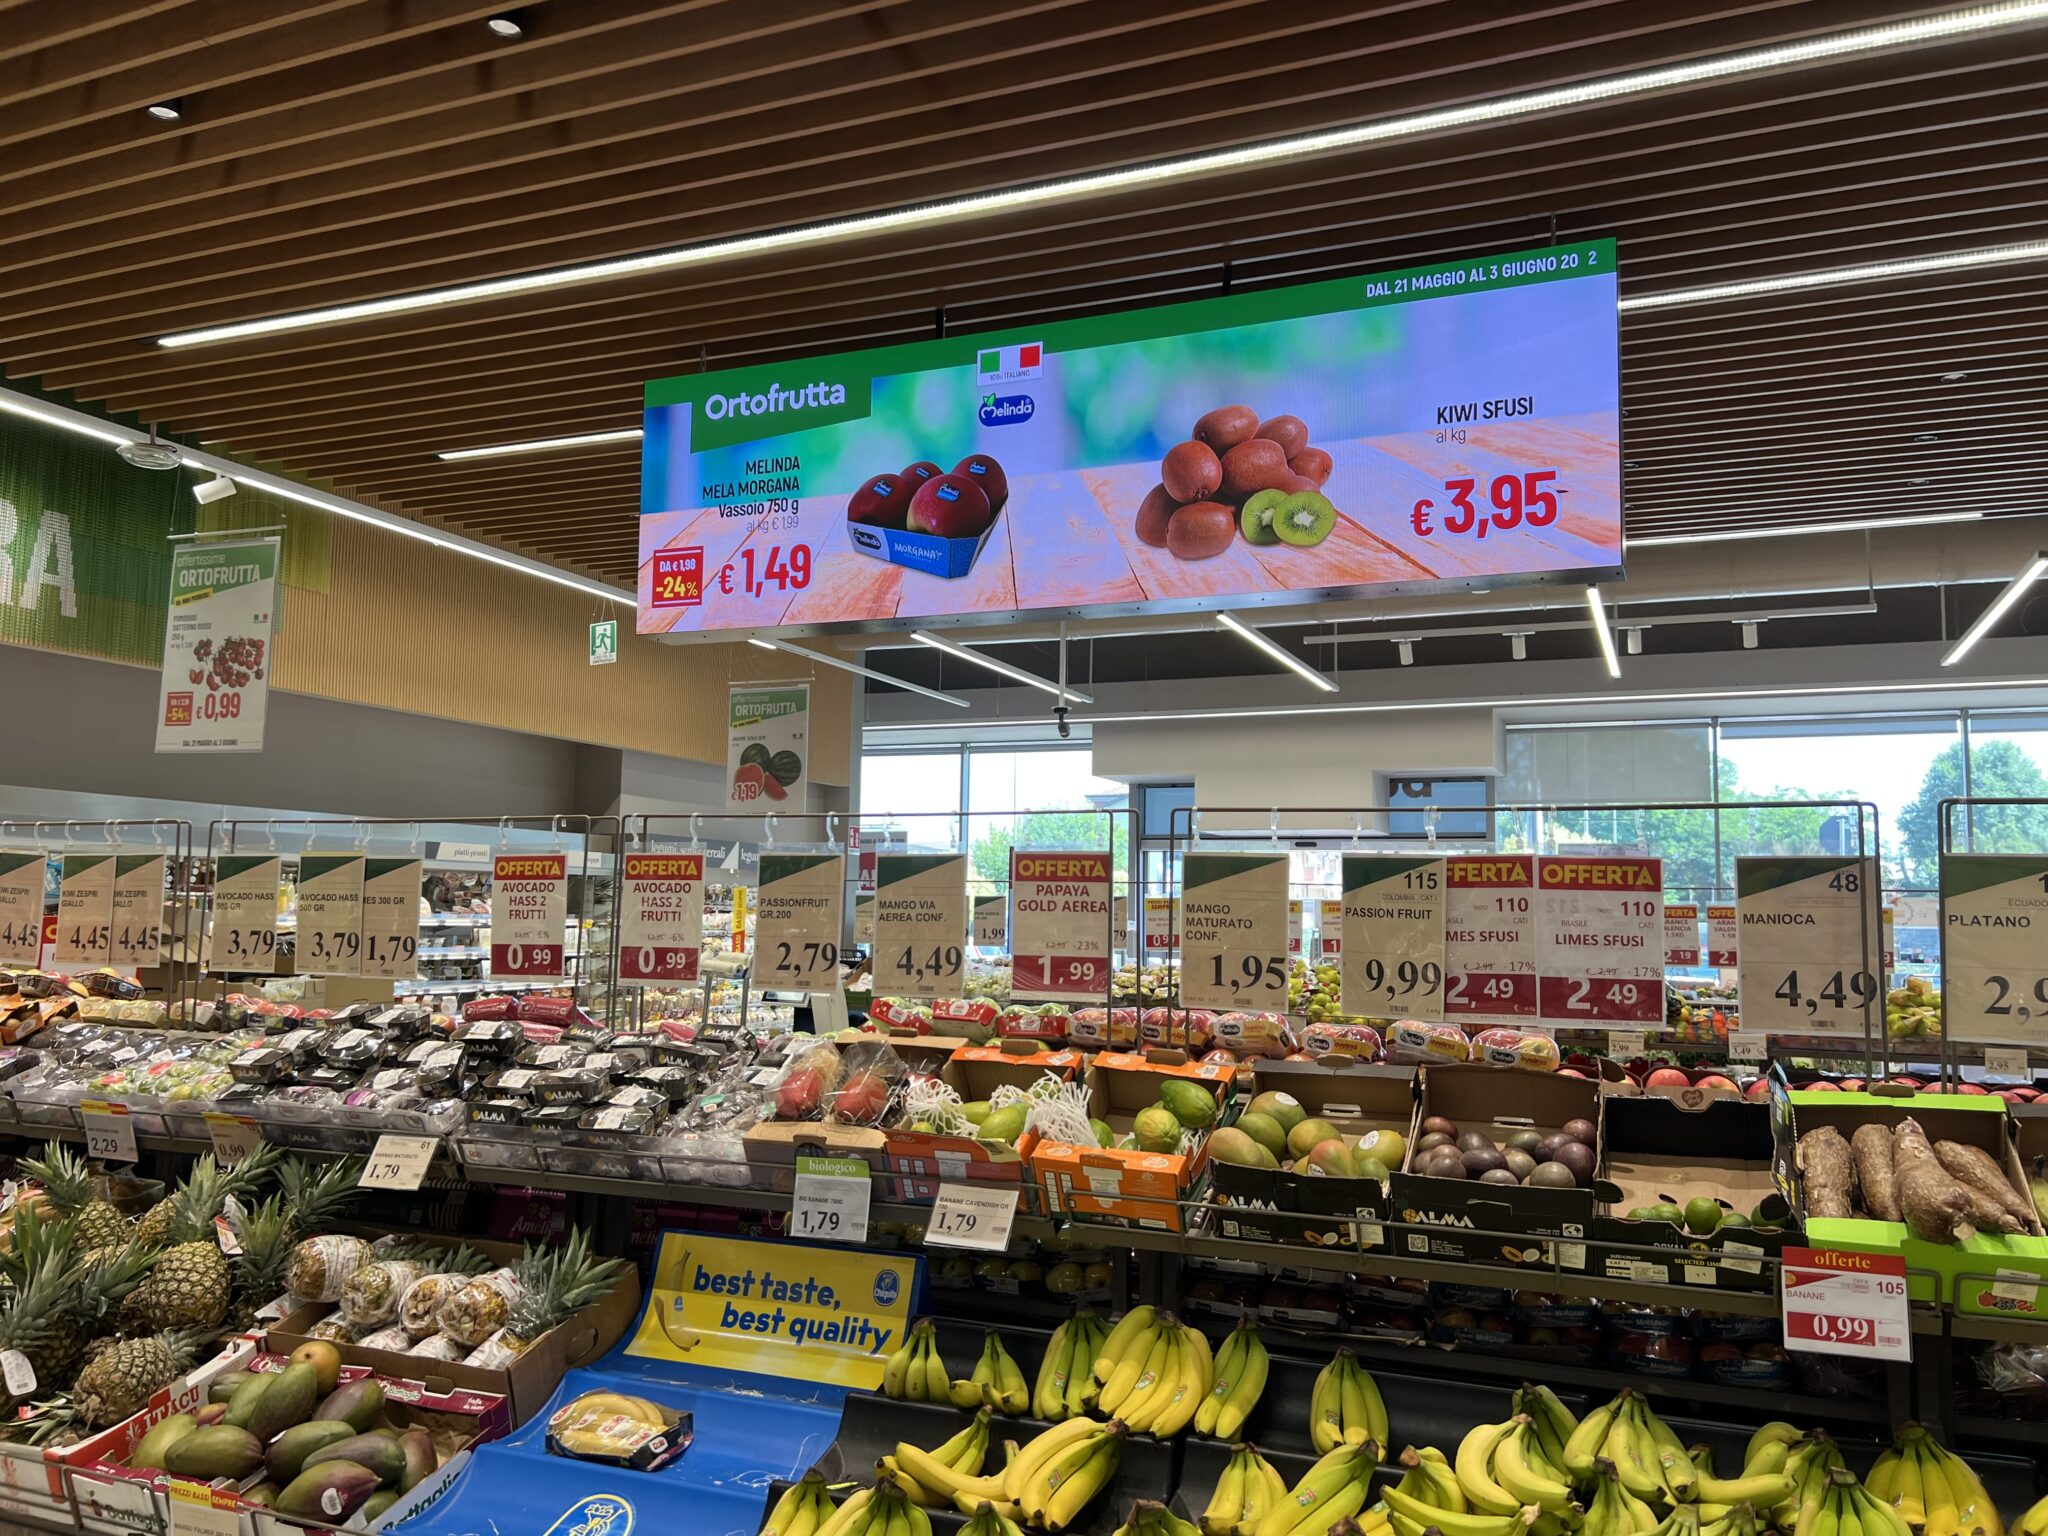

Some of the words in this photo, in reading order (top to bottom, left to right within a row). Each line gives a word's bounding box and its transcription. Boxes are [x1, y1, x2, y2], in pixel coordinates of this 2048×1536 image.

[1366, 283, 1391, 297] DAL
[1394, 278, 1408, 292] 21
[1412, 270, 1465, 290] MAGGIO
[1469, 267, 1486, 282] AL
[1490, 265, 1498, 280] 3
[1502, 256, 1556, 278] GIUGNO
[1004, 370, 1030, 378] ITALIANO
[705, 381, 846, 421] Ortofrutta
[981, 400, 1032, 419] Melinda
[1436, 404, 1478, 424] KIWI
[1482, 396, 1534, 421] SFUSI
[1436, 428, 1448, 444] al
[1450, 428, 1466, 444] kg
[746, 456, 800, 476] MELINDA
[702, 482, 734, 500] MELA
[738, 476, 800, 496] MORGANA
[719, 502, 764, 518] Vassoio
[768, 498, 788, 513] 750
[792, 499, 799, 514] g
[1410, 499, 1434, 536] €
[1444, 470, 1557, 538] 3,95
[747, 520, 755, 532] al
[772, 517, 779, 530] €
[782, 516, 799, 530] 1,99
[894, 543, 936, 558] MORGANA
[660, 561, 672, 572] DA
[672, 562, 678, 571] €
[680, 558, 696, 572] 1,98
[718, 564, 735, 594] €
[741, 544, 812, 598] 1,49
[180, 564, 260, 587] ORTOFRUTTA
[656, 576, 697, 598] -24%
[204, 692, 241, 722] 0,99
[735, 702, 797, 716] ORTOFRUTTA
[736, 782, 758, 802] 1,19
[496, 860, 561, 876] OFFERTA
[627, 860, 698, 876] OFFERTA
[1018, 860, 1106, 878] OFFERTA
[1543, 863, 1654, 886] OFFERTA
[502, 883, 555, 893] AVOCADO
[633, 883, 692, 894] AVOCADO
[1404, 873, 1438, 889] 115
[1829, 873, 1859, 892] 48
[217, 893, 252, 901] AVOCADO
[301, 894, 337, 902] AVOCADO
[338, 894, 359, 902] HASS
[1036, 884, 1090, 897] PAPAYA
[314, 904, 325, 912] GR
[378, 897, 391, 905] 300
[393, 897, 405, 905] GR
[509, 896, 538, 907] HASS
[540, 896, 546, 907] 2
[642, 897, 673, 908] HASS
[676, 897, 682, 908] 2
[760, 898, 829, 907] PASSIONFRUIT
[879, 900, 916, 910] MANGO
[919, 901, 936, 909] VIA
[1018, 900, 1056, 912] GOLD
[1061, 900, 1108, 913] AEREA
[1495, 898, 1529, 912] 110
[1621, 901, 1655, 916] 110
[509, 909, 546, 920] FRUTTI
[641, 911, 682, 922] FRUTTI
[878, 913, 913, 922] AEREA
[916, 913, 946, 922] CONF.
[1186, 904, 1231, 915] MANGO
[1345, 907, 1393, 918] PASSION
[1398, 909, 1432, 920] FRUIT
[1186, 918, 1253, 929] MATURATO
[1743, 913, 1816, 926] MANIOCA
[1948, 915, 2031, 928] PLATANO
[2, 922, 38, 950] 4,45
[70, 925, 109, 953] 4,45
[119, 926, 159, 956] 4,45
[1186, 931, 1221, 941] CONF.
[1446, 931, 1475, 942] MES
[1480, 931, 1519, 942] SFUSI
[1555, 934, 1598, 945] LIMES
[1603, 935, 1644, 947] SFUSI
[227, 929, 275, 960] 3,79
[311, 932, 360, 964] 3,79
[366, 936, 416, 966] 1,79
[507, 944, 551, 970] 0,99
[638, 946, 685, 973] 0,99
[776, 942, 837, 977] 2,79
[897, 946, 962, 983] 4,49
[1037, 955, 1095, 985] 1,99
[1210, 954, 1285, 994] 1,95
[1366, 959, 1441, 1001] 9,99
[1567, 977, 1638, 1014] 2,49
[1775, 970, 1877, 1016] 4,49
[664, 1056, 690, 1067] ALMA
[479, 1111, 505, 1121] ALMA
[91, 1138, 117, 1154] 2,29
[421, 1141, 431, 1149] 61
[369, 1164, 400, 1181] 1,79
[809, 1160, 856, 1176] biologico
[939, 1196, 964, 1205] BANANE
[965, 1199, 999, 1209] CAVENDISH
[1227, 1195, 1278, 1211] ALMA
[801, 1210, 840, 1233] 1,79
[938, 1212, 976, 1233] 1,79
[1415, 1210, 1475, 1228] ALMA
[1815, 1251, 1871, 1268] offerte
[693, 1265, 755, 1296] best
[761, 1272, 841, 1311] taste,
[1787, 1290, 1825, 1300] BANANE
[1877, 1281, 1904, 1295] 105
[721, 1301, 786, 1334] best
[788, 1315, 893, 1354] quality
[1813, 1315, 1868, 1343] 0,99
[171, 1486, 191, 1500] PREZZI
[192, 1492, 210, 1502] BASSI
[212, 1496, 237, 1507] SEMPRE
